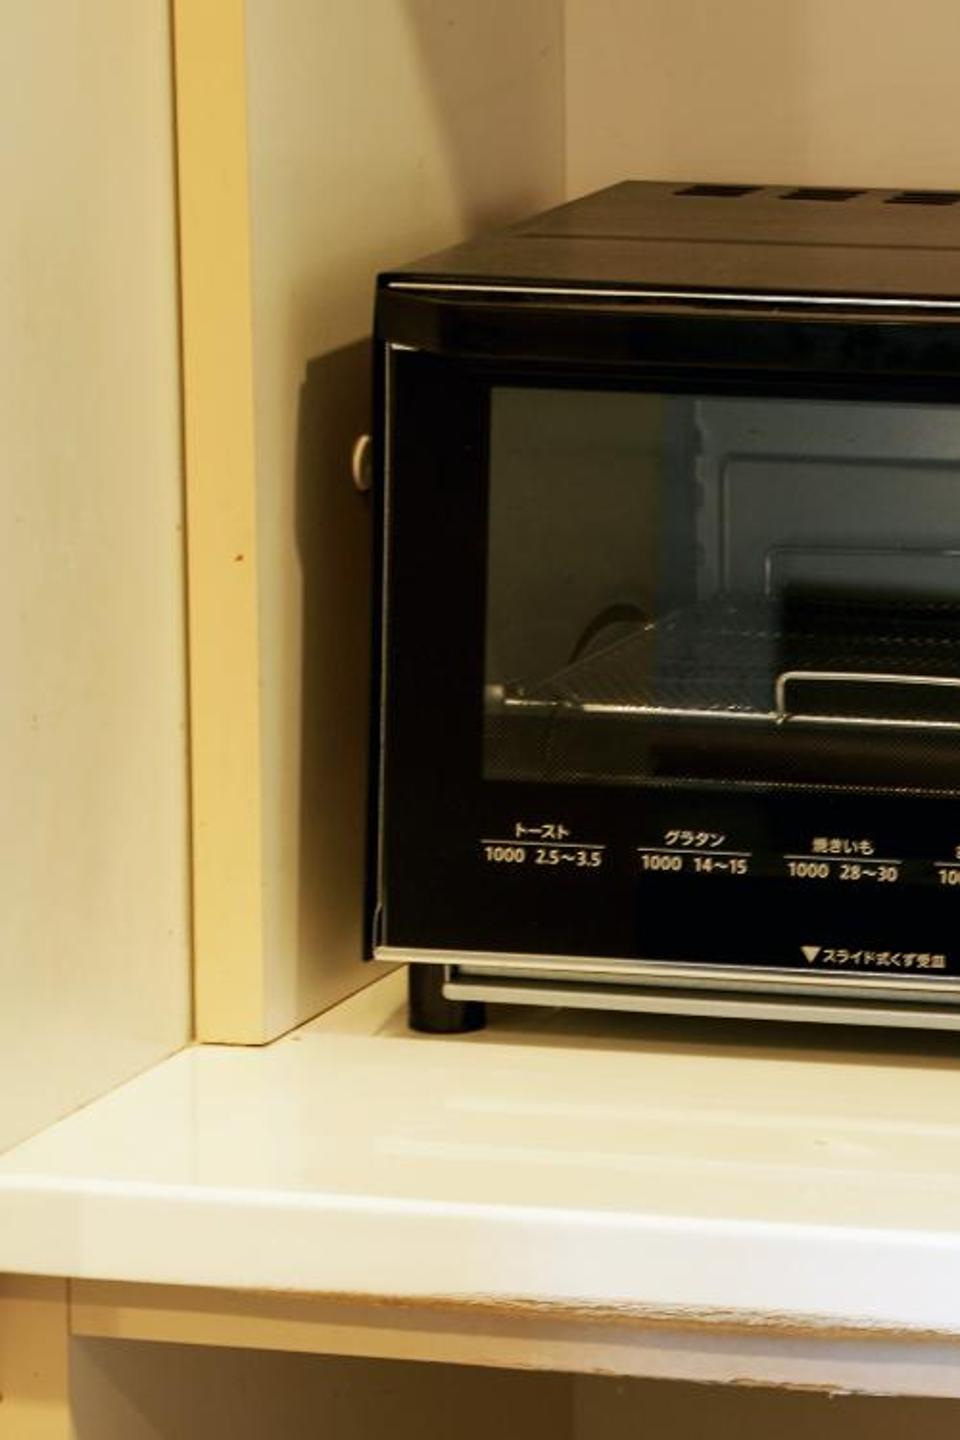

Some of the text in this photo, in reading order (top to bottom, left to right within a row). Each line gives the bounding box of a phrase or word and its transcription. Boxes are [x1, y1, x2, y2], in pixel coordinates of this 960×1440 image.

[514, 823, 569, 840] トースト
[664, 830, 726, 848] グラタン
[485, 847, 525, 864] 1000
[642, 855, 682, 872] 1000
[788, 862, 829, 879] 1000
